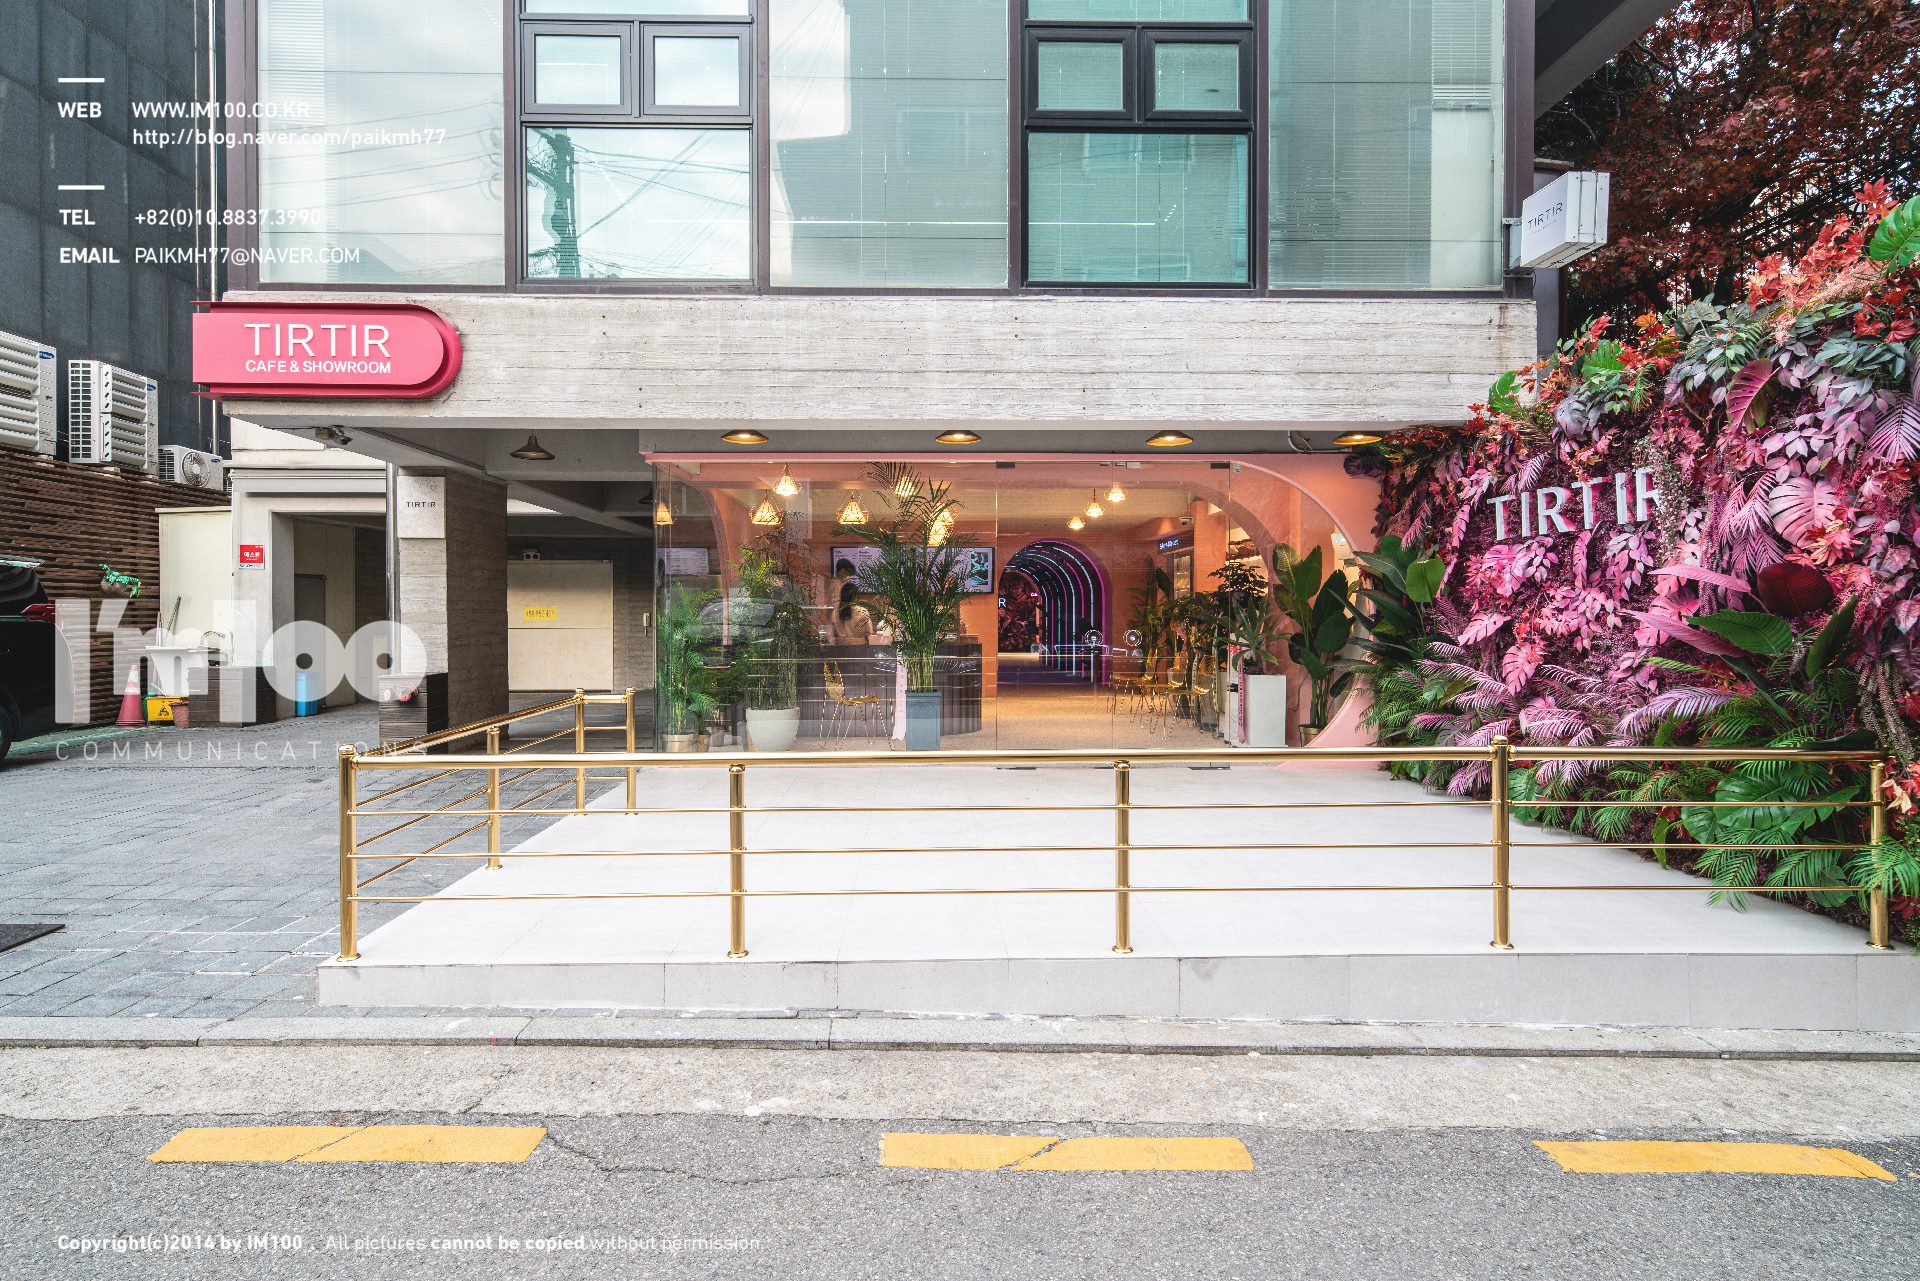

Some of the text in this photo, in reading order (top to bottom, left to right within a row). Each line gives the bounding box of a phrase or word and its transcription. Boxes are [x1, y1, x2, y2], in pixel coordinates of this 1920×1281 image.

[1528, 202, 1563, 228] TIRTIR
[244, 323, 391, 358] TIRTIR
[245, 360, 391, 373] CAFE & SHOWROOM
